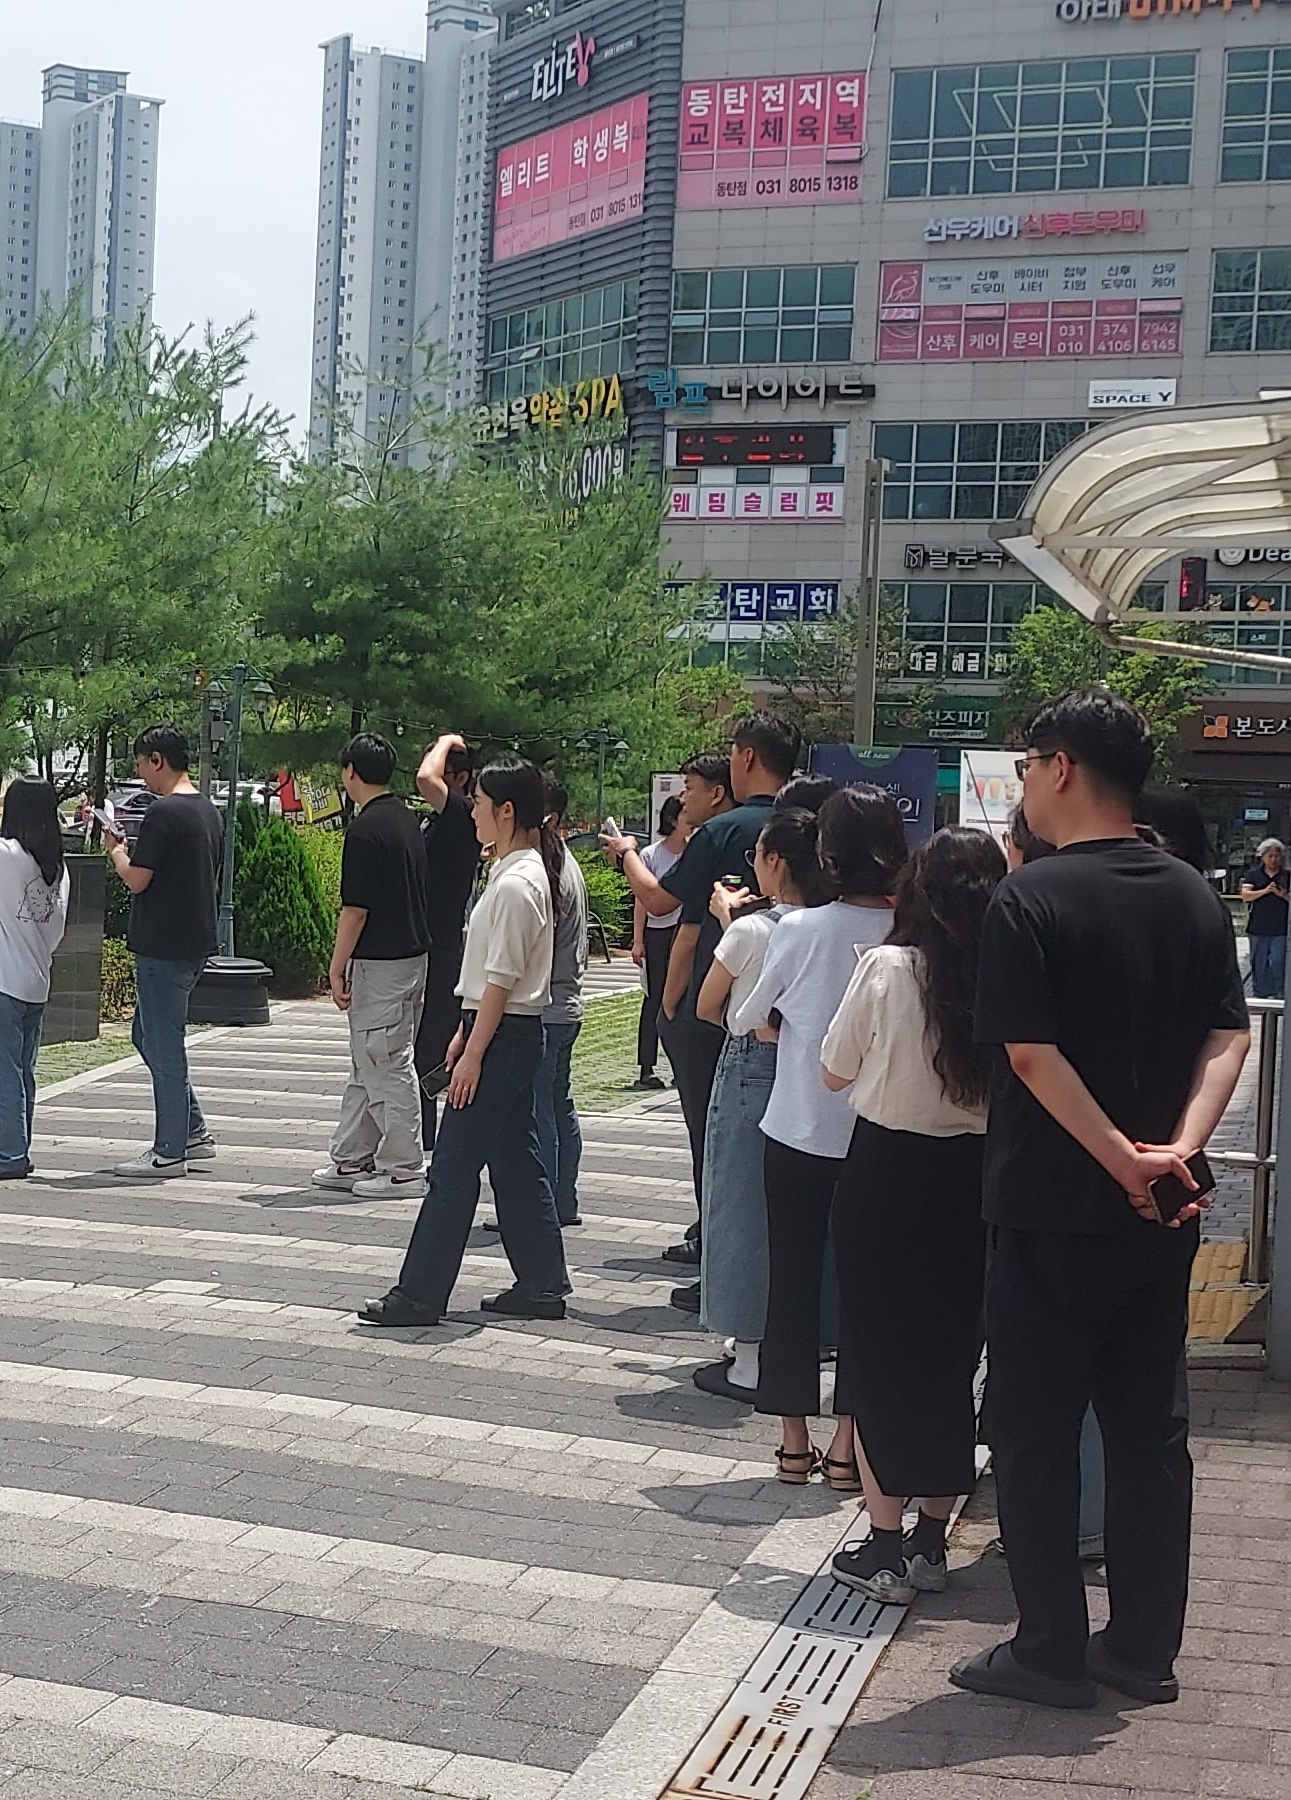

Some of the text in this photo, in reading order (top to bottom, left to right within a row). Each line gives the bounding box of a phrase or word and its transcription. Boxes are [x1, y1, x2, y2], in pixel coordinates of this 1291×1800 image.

[687, 78, 860, 117] 동탄전지역
[686, 114, 857, 146] 교복체육복
[500, 121, 629, 198] 엘리트 학생복
[716, 175, 858, 197] 동탄점 031 8015 1318
[590, 206, 604, 224] 031
[608, 198, 626, 217] 8015
[1059, 321, 1177, 337] 031 374 7942
[926, 331, 1043, 352] 산후 케어 문의
[1057, 341, 1083, 353] 010
[1140, 338, 1177, 351] 6145
[721, 368, 868, 412] 다이어트
[1092, 391, 1172, 404] SPACE Y
[672, 491, 834, 513] 웨딩슬림핏
[929, 545, 1017, 569] 달문국
[767, 1694, 805, 1727] FIRST
